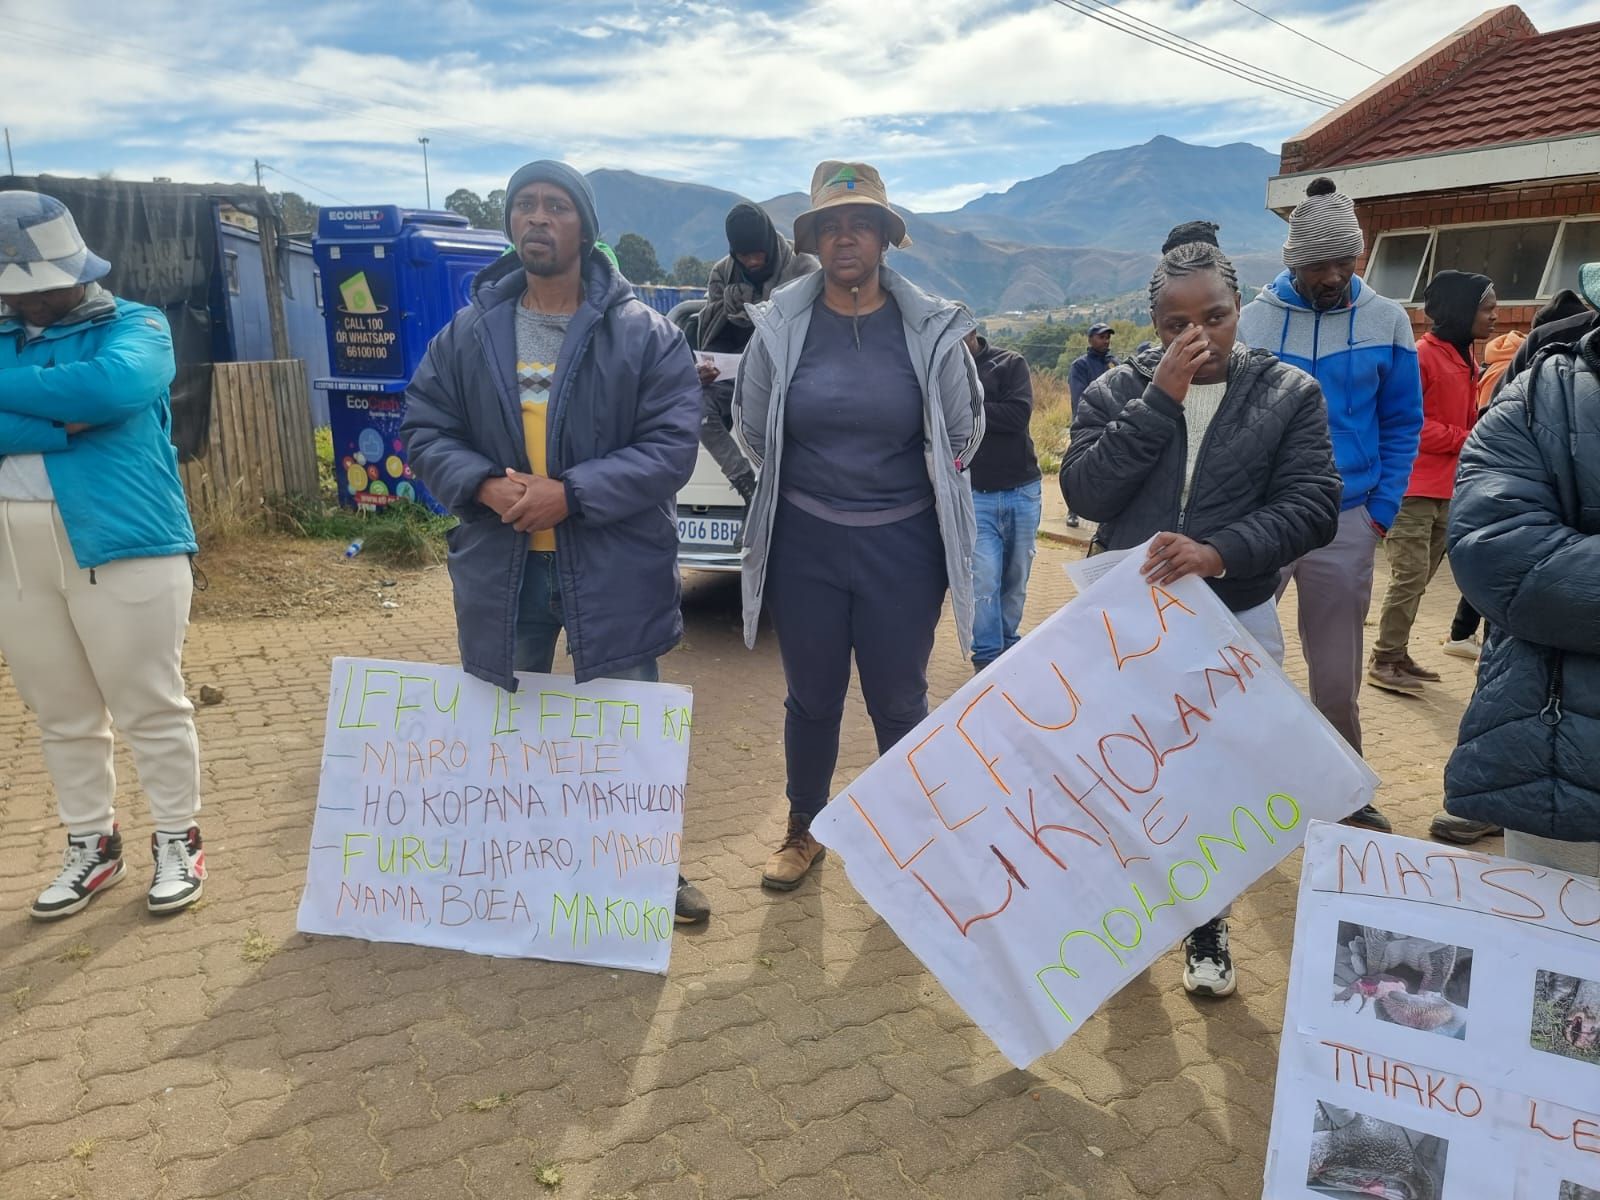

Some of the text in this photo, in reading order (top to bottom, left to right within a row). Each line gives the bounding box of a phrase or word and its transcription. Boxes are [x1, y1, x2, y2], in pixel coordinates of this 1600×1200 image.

[329, 210, 379, 221] ECONET
[336, 330, 396, 345] OR WHATSAPP
[344, 317, 384, 330] CALL 100
[346, 345, 387, 359] 66100100
[678, 520, 739, 541] 906 BBH
[337, 665, 692, 744] LEFU LE FETA KA
[849, 584, 1197, 870] LEFU LA
[362, 738, 468, 785] MARO
[489, 741, 509, 777] A
[362, 784, 407, 827] HO
[421, 783, 548, 828] KOPANA
[910, 644, 1263, 938] LIKHOLANA
[1108, 796, 1190, 869] LE
[550, 890, 673, 951] MAKOKO
[1035, 793, 1301, 1024] MOLOMO
